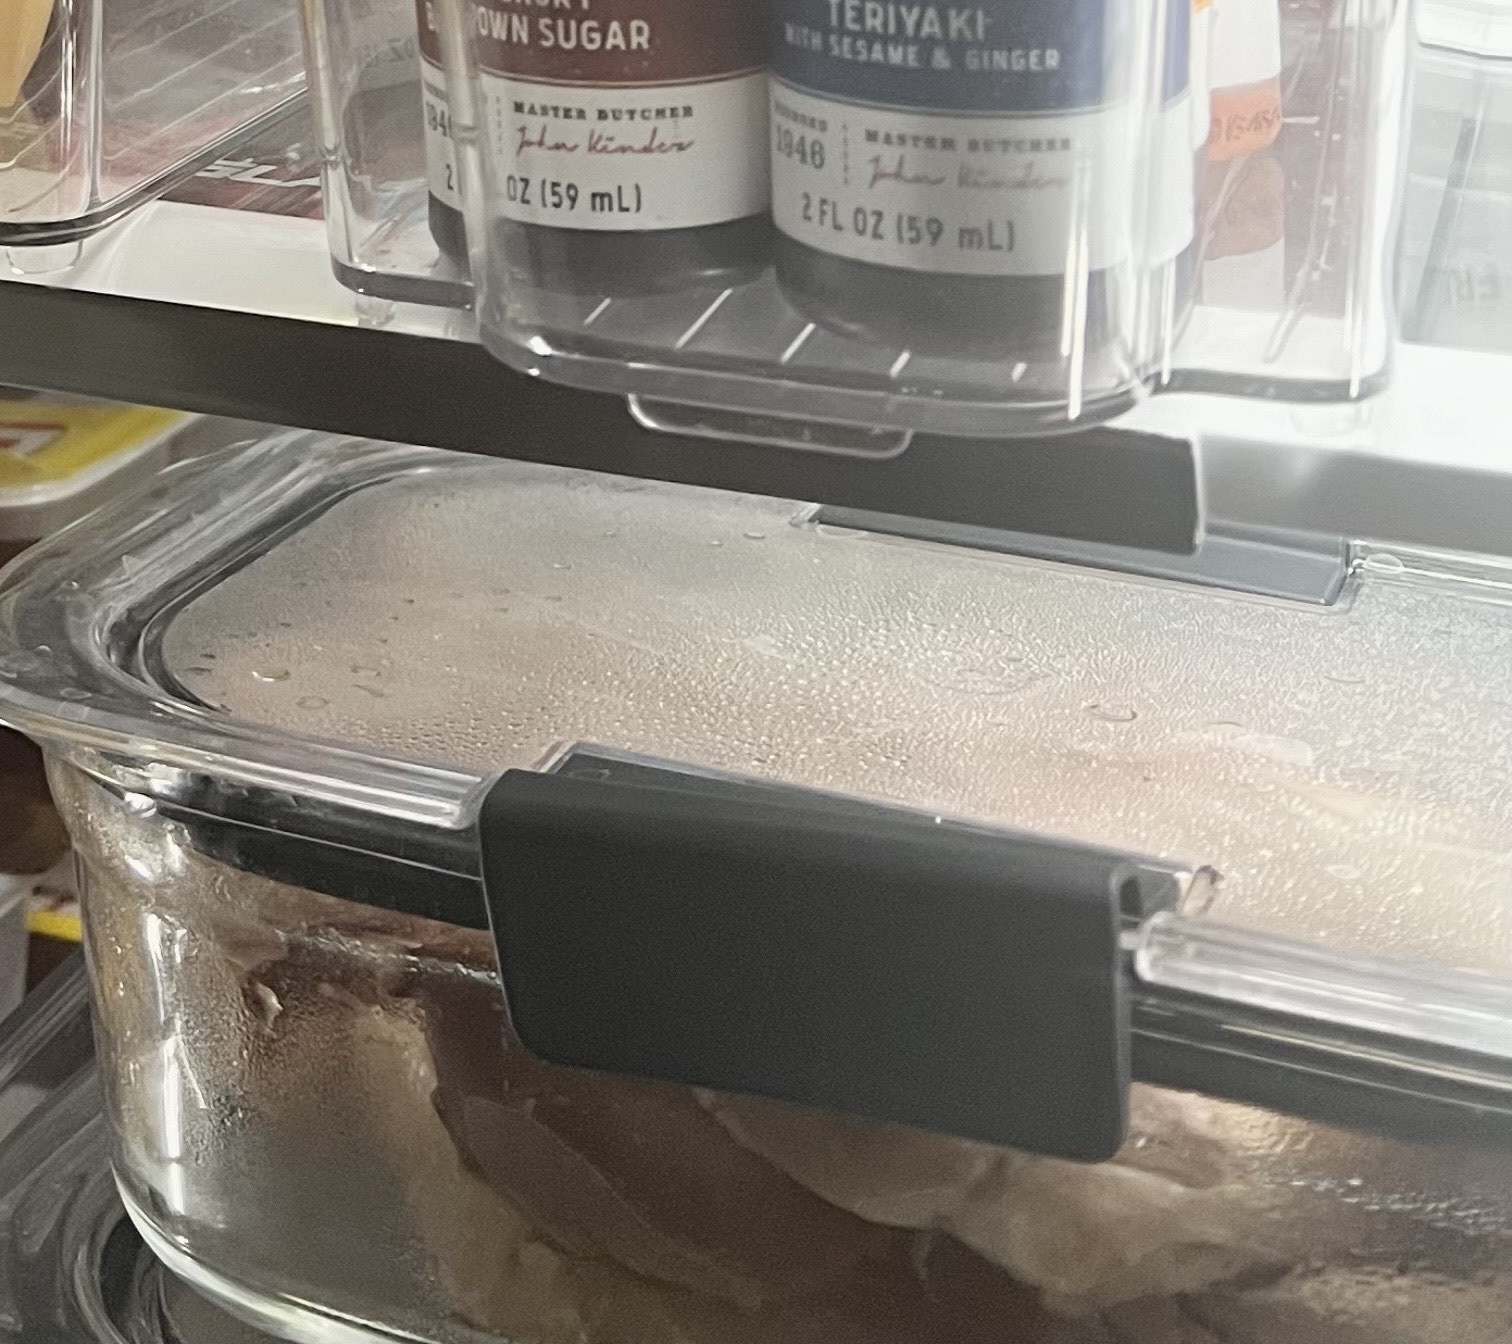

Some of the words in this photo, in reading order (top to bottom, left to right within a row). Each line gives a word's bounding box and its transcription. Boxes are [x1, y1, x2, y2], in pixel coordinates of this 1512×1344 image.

[538, 16, 651, 51] SUGAR
[829, 34, 920, 68] SESAME
[931, 47, 951, 70] &
[965, 49, 1060, 71] GINGER
[513, 101, 586, 120] MASTER
[596, 104, 693, 123] BUTCHER
[507, 175, 531, 205] OZ
[541, 179, 579, 210] (59
[591, 183, 643, 213] mL)
[802, 192, 812, 221] 2
[819, 198, 844, 231] FL
[854, 207, 884, 240] OZ
[897, 213, 944, 246] (59
[958, 220, 1016, 252] mL)
